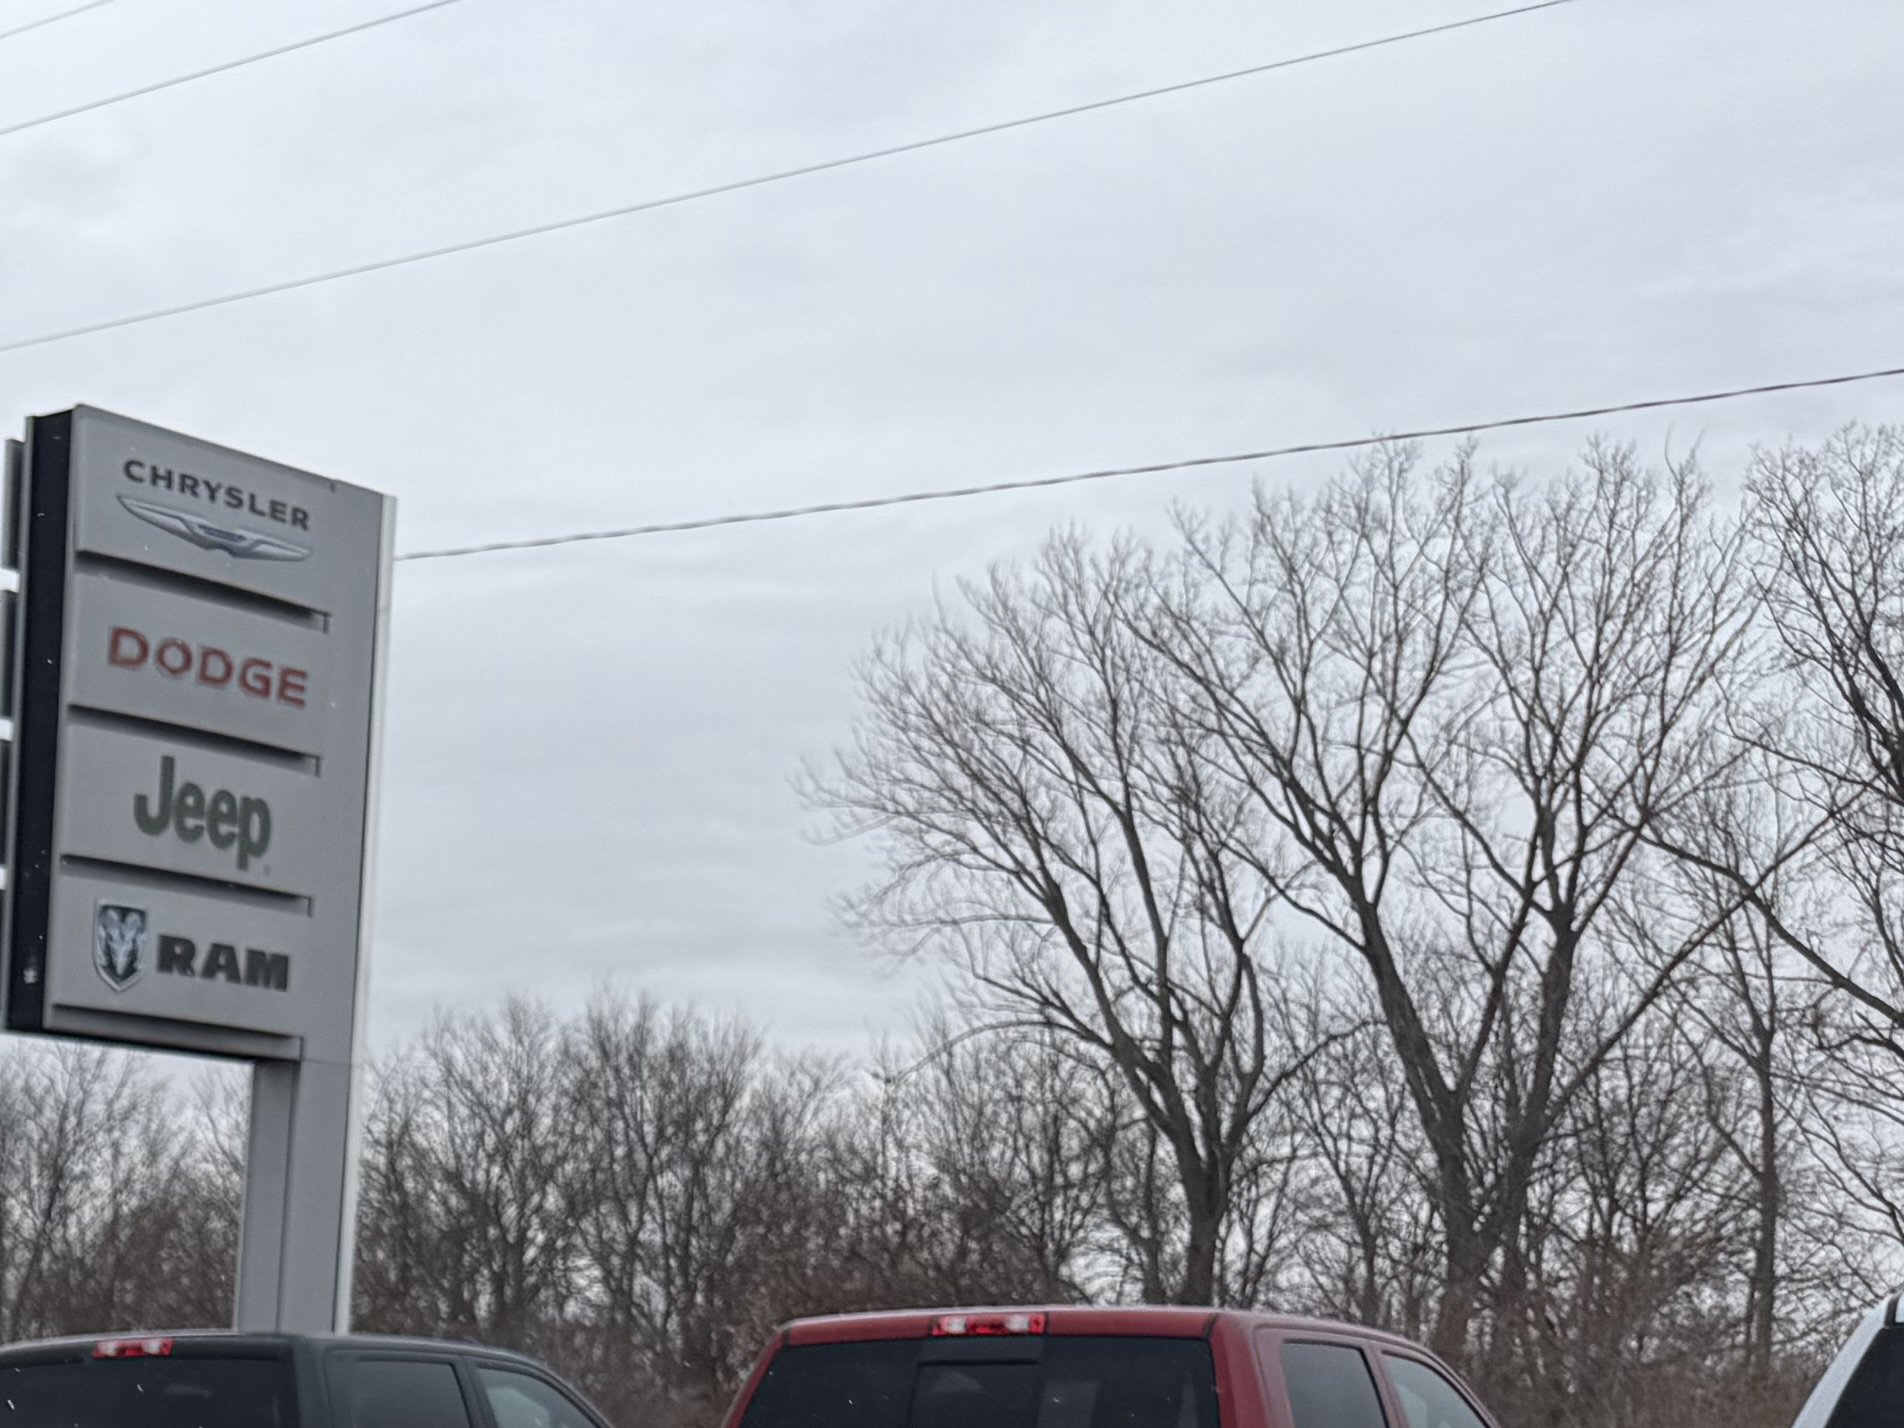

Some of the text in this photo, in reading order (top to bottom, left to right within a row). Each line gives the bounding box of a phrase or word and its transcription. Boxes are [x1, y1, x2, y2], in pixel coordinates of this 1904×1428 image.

[123, 460, 309, 531] CHRYSLER
[108, 627, 308, 709] DODGE
[133, 755, 272, 871] Jeep
[156, 933, 290, 992] RAM
